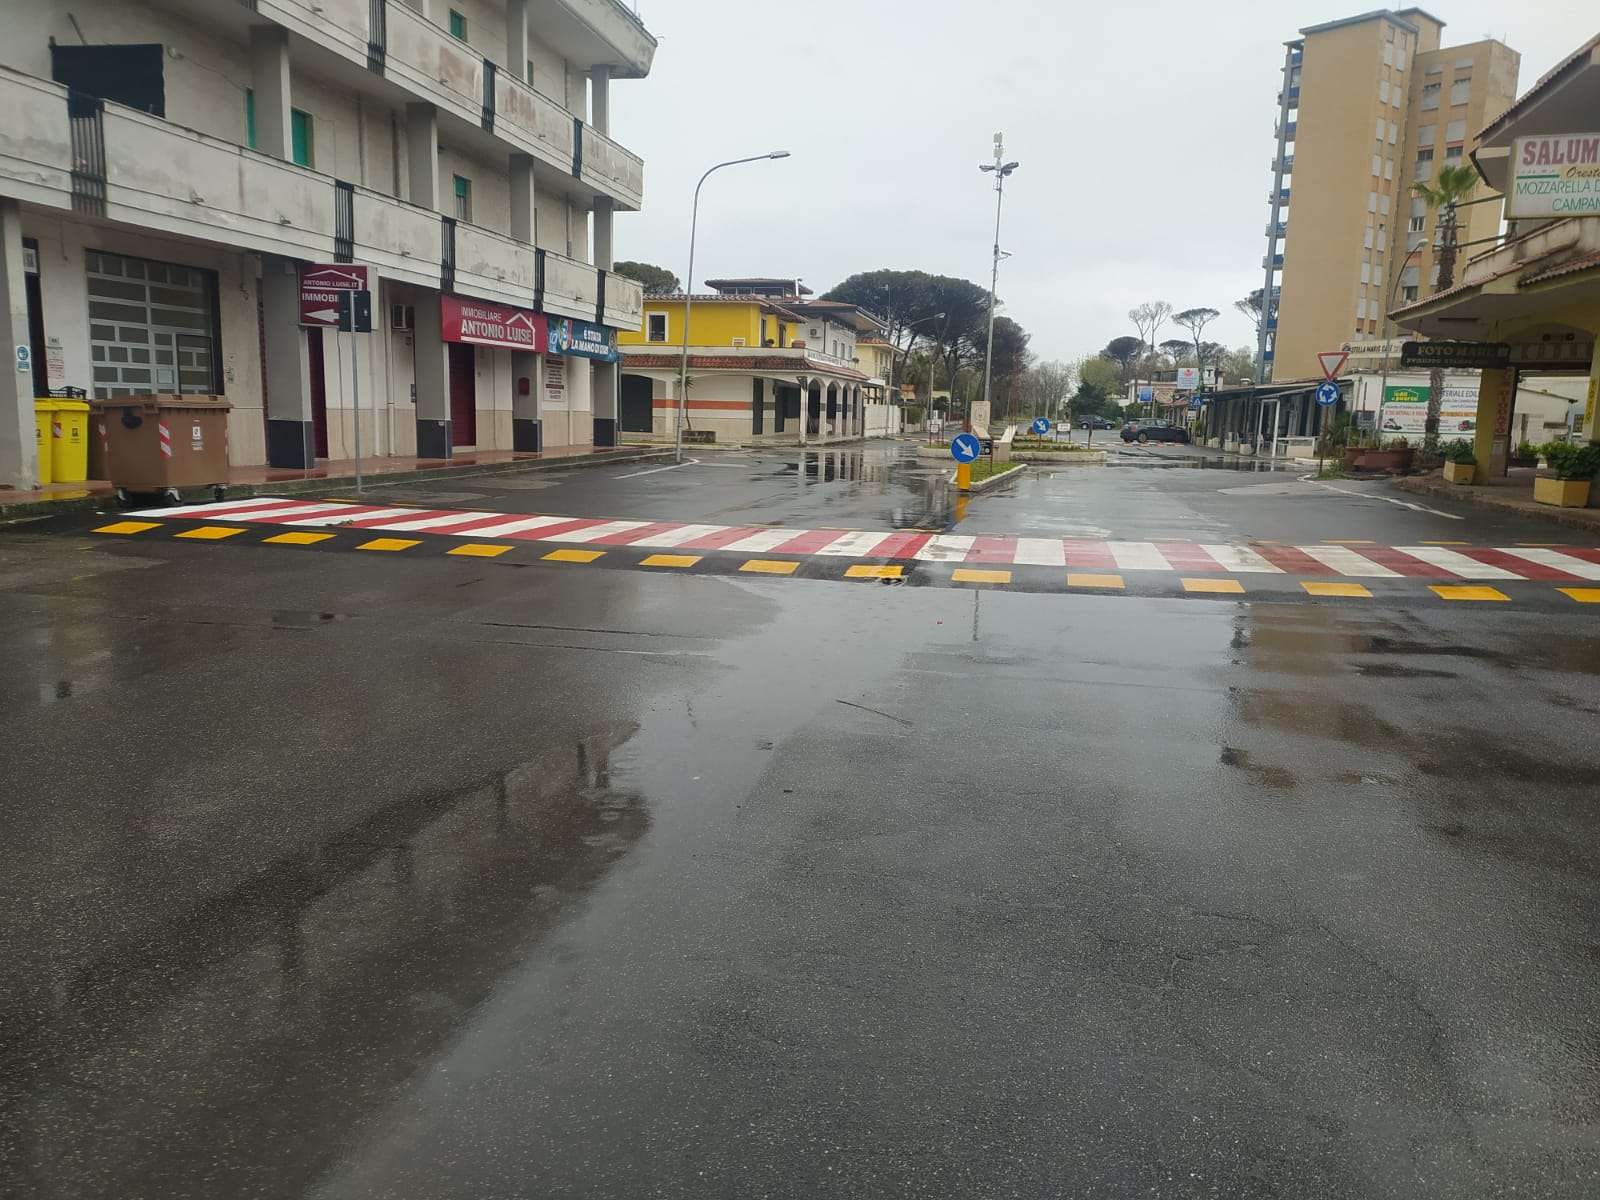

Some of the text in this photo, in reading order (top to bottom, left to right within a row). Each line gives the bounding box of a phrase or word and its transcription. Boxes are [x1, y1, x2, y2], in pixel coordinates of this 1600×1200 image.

[1516, 180, 1590, 195] MOZZARELLA
[462, 305, 502, 322] IMMOBILIARE
[461, 319, 532, 343] ANTONIO LUISE
[1416, 345, 1454, 356] FOTO
